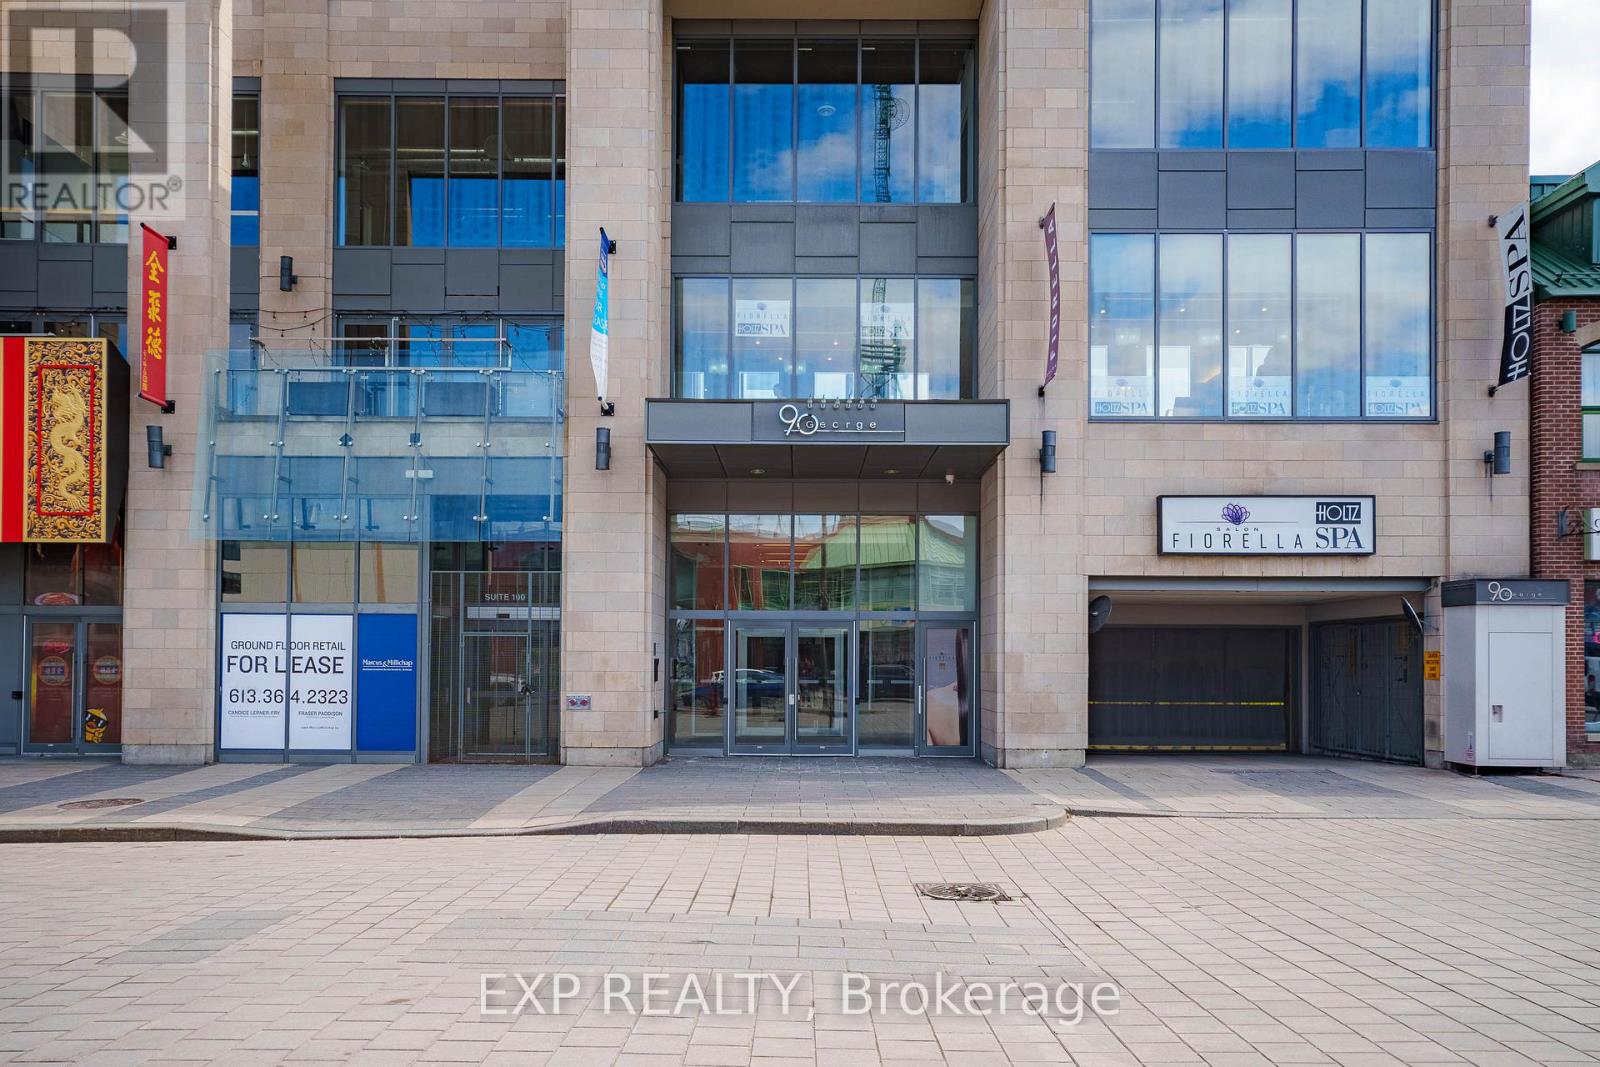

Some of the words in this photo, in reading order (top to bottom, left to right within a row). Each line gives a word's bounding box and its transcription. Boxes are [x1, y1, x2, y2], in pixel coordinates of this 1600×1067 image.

[1504, 208, 1530, 299] SPA
[762, 323, 785, 335] SPA
[1507, 293, 1530, 381] HOLTZ
[1122, 402, 1147, 414] SPA
[1259, 402, 1286, 414] SPA
[779, 404, 819, 436] 90
[1316, 503, 1361, 523] HOLTZ
[1172, 533, 1303, 549] FIORELLA
[1316, 526, 1365, 549] SPA
[485, 593, 509, 601] SUITE
[512, 593, 526, 601] 100
[1488, 581, 1513, 601] 90
[231, 640, 273, 650] GROUND
[275, 641, 310, 650] FLOOR
[313, 642, 346, 650] RETAIL
[227, 655, 268, 673] FOR
[275, 656, 344, 674] LEASE
[229, 688, 348, 705] 613.364.2323
